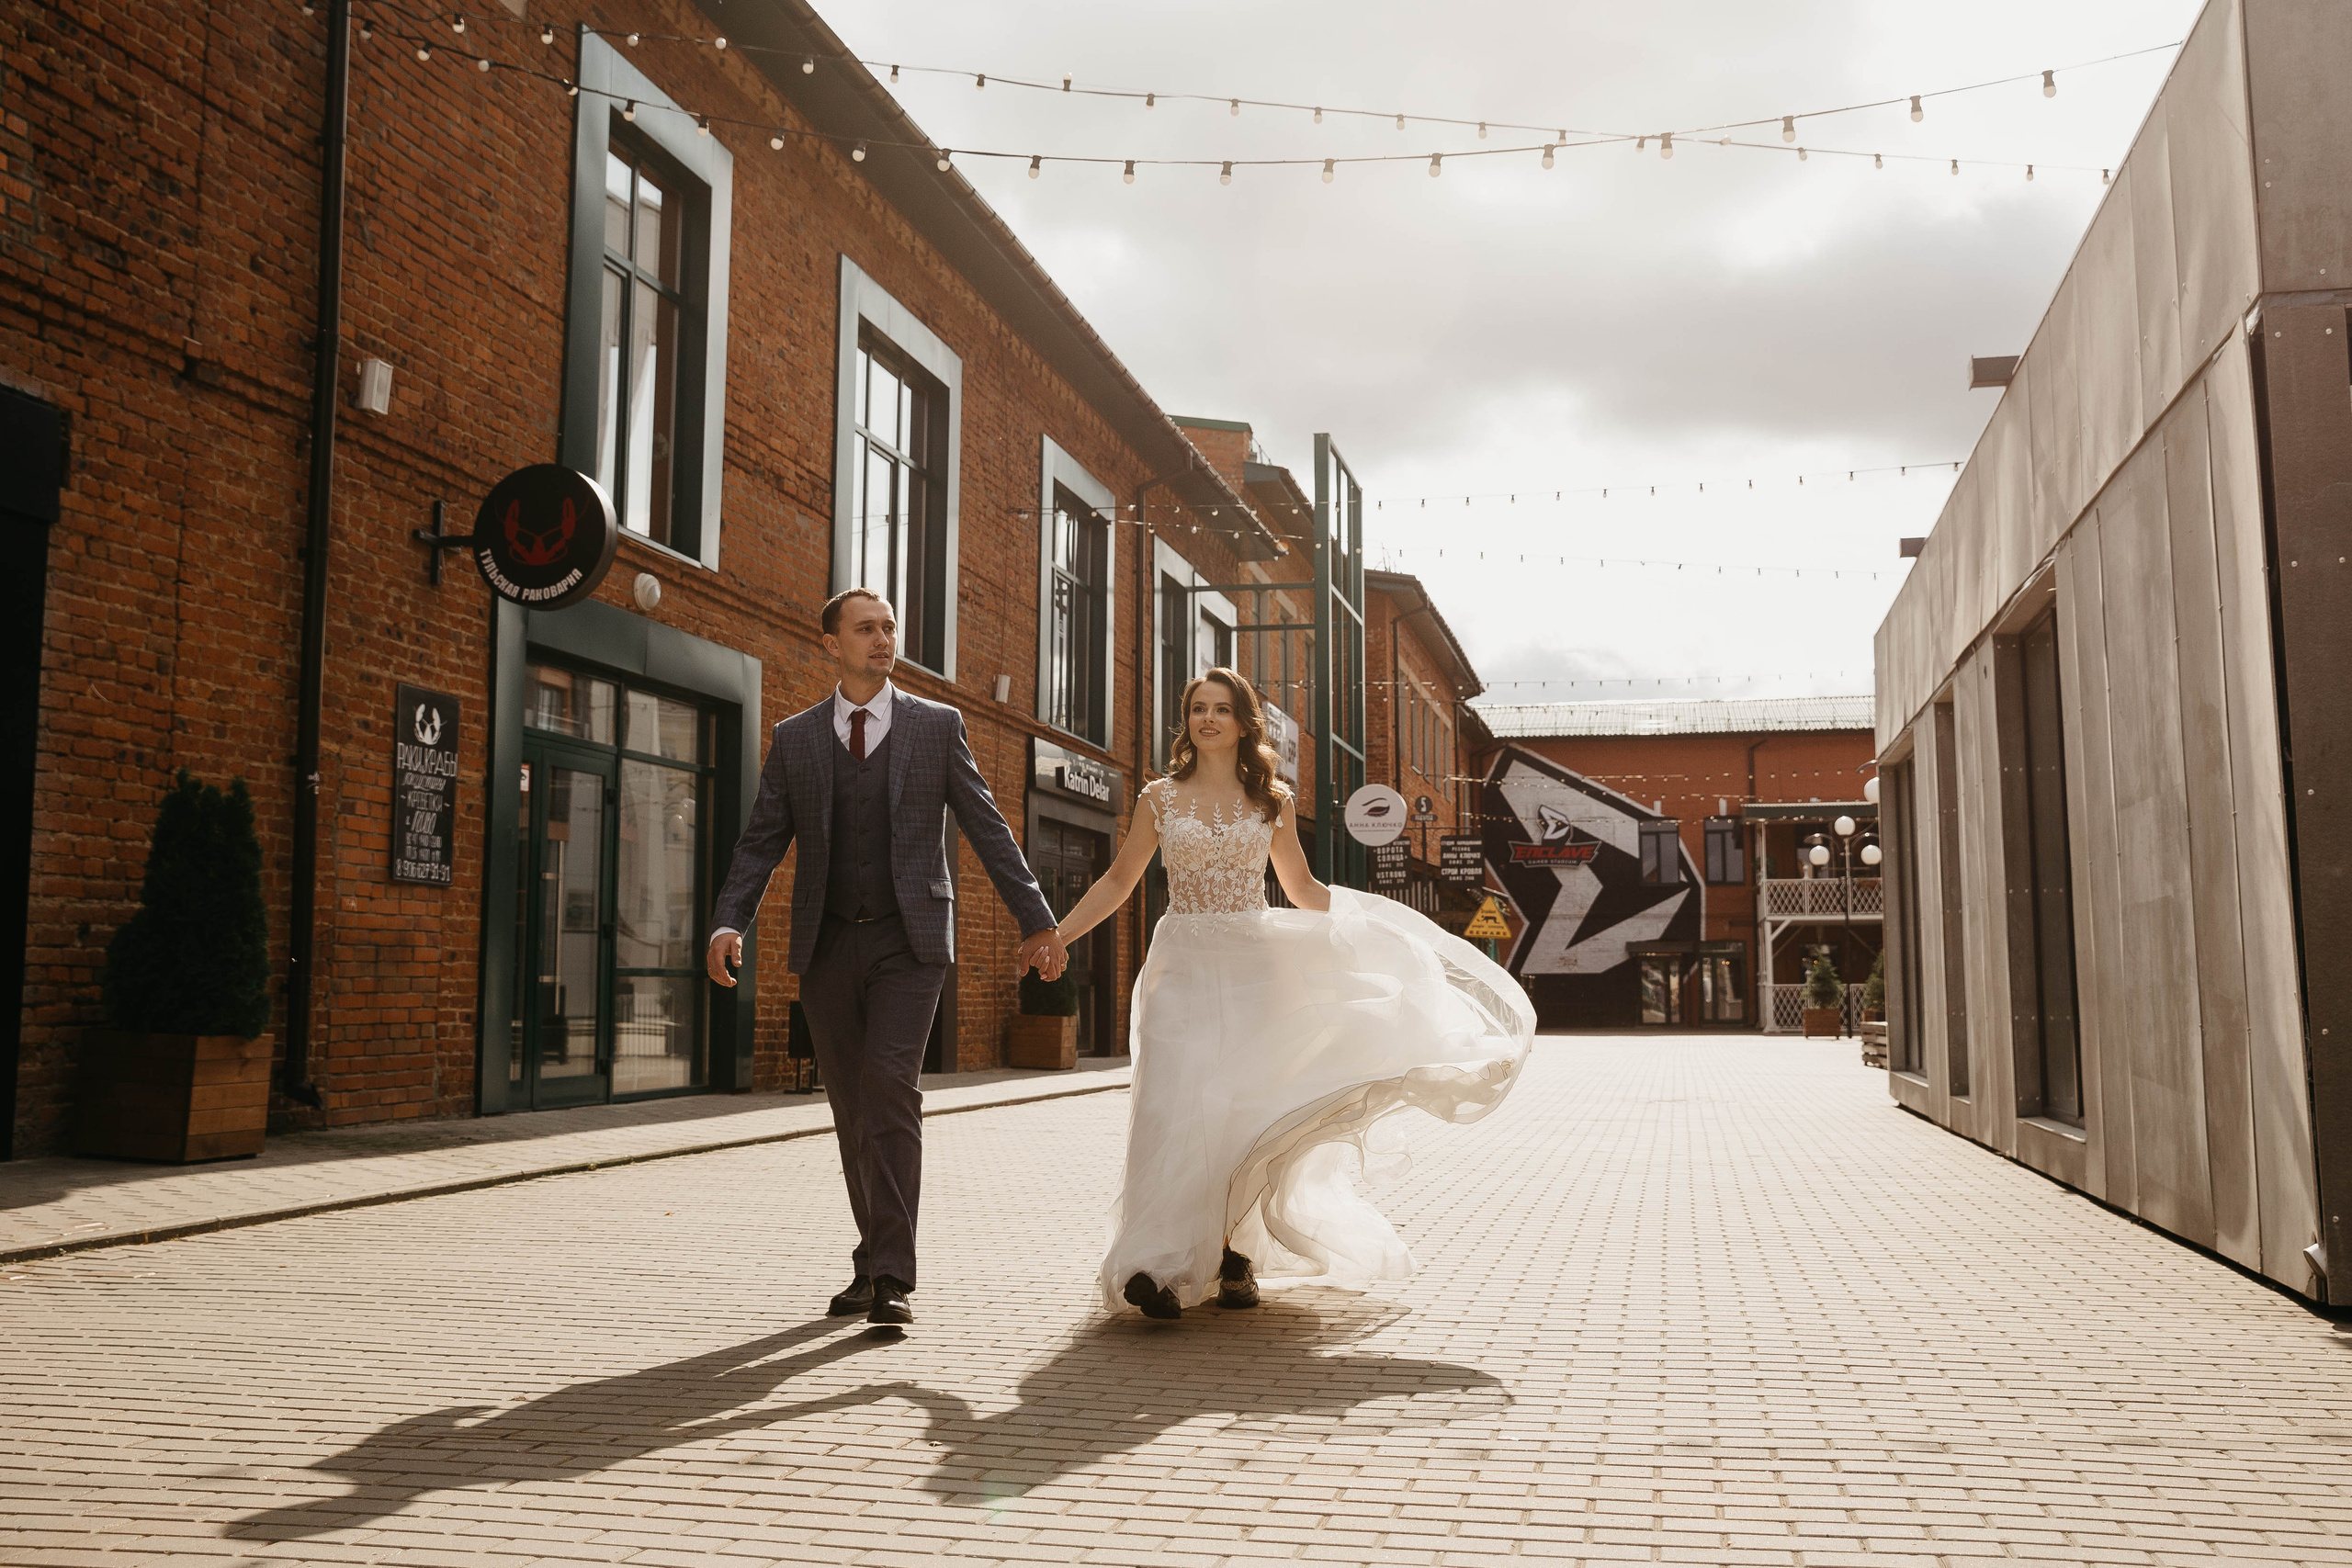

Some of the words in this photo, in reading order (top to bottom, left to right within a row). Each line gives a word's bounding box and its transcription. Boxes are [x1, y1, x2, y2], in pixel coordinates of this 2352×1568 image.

[480, 548, 520, 598] ТУЛЬСКАЯ
[522, 568, 583, 601] РАКОВАРНЯ
[1064, 765, 1089, 795] Katrin
[1089, 775, 1110, 802] Delar
[1420, 796, 1427, 813] 5
[1514, 846, 1594, 859] ENCLAVE
